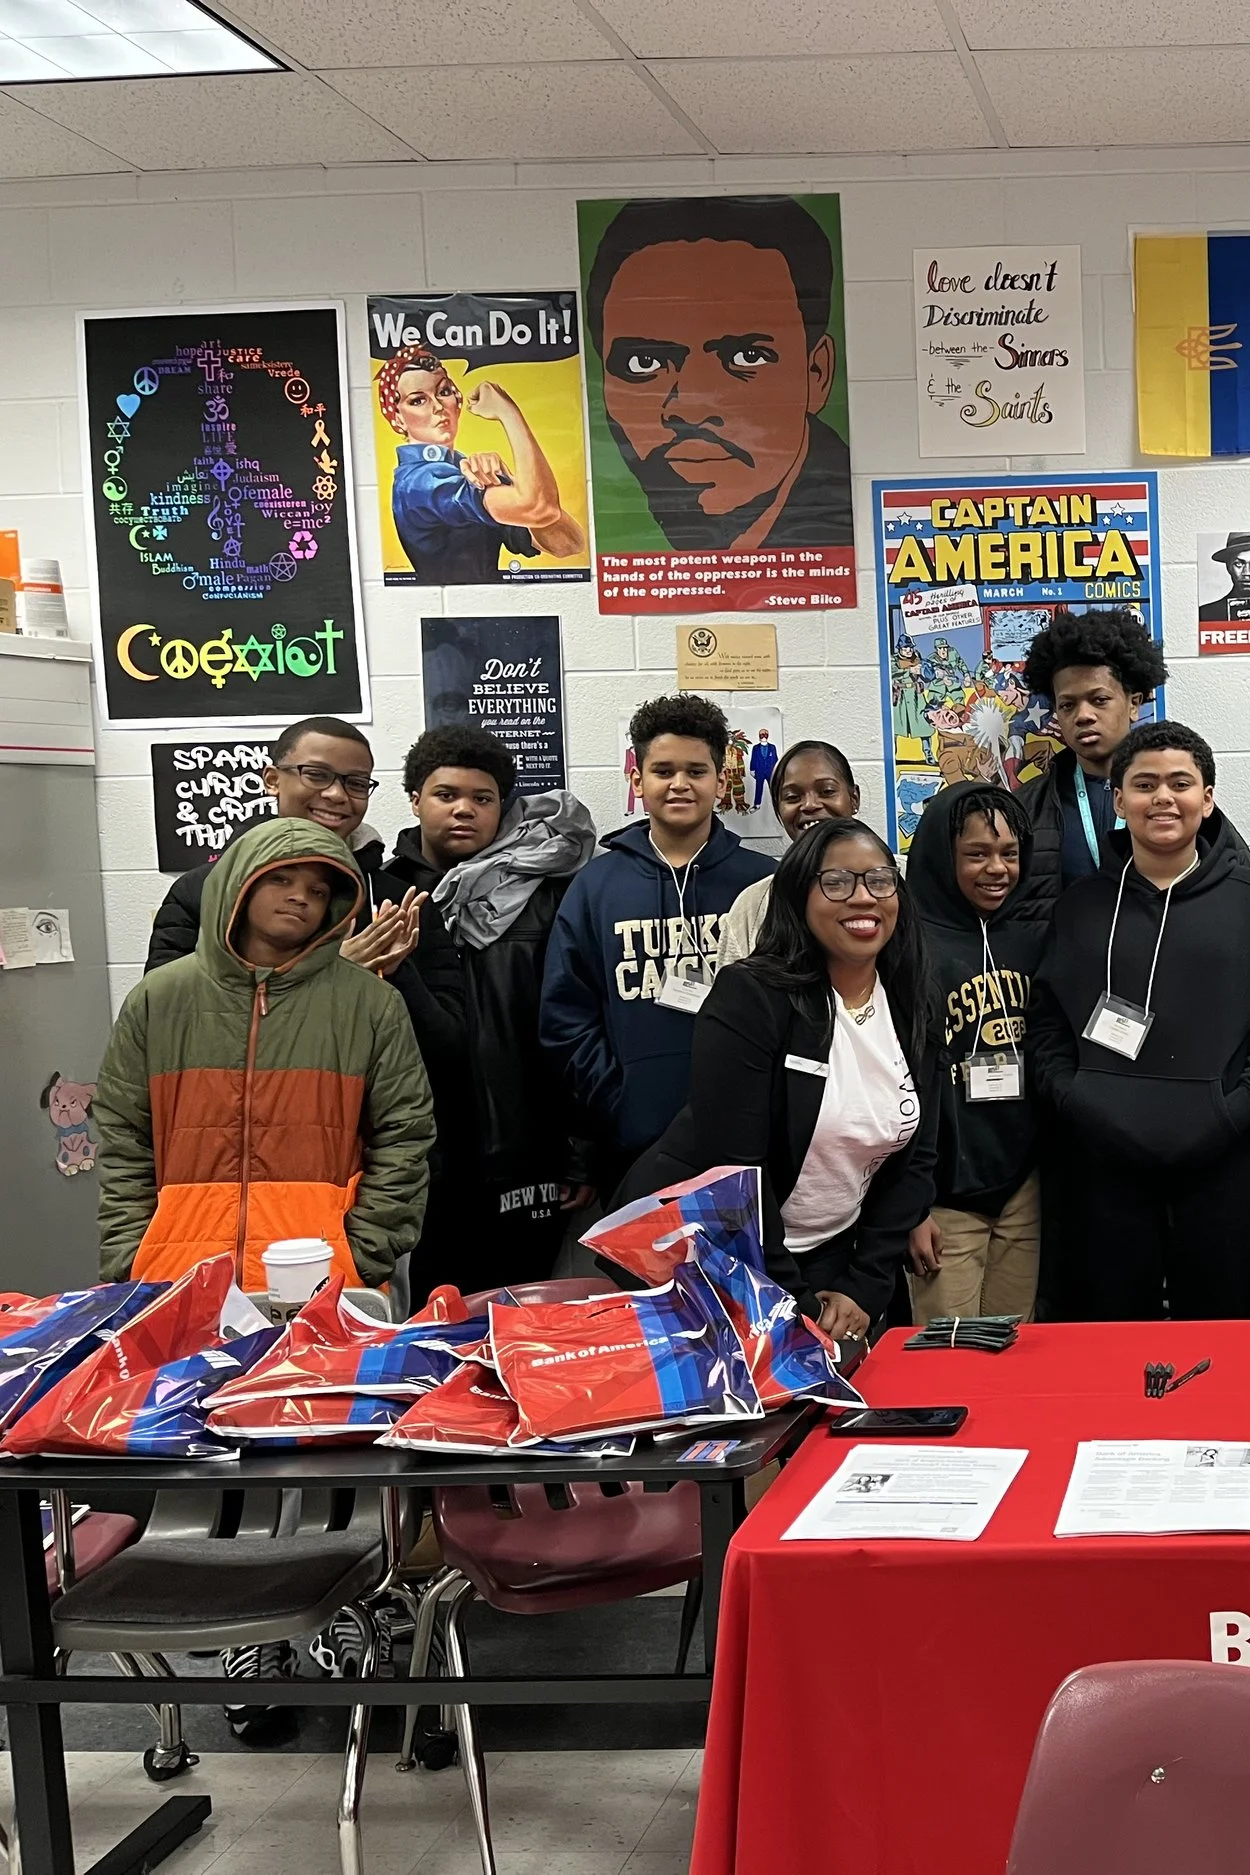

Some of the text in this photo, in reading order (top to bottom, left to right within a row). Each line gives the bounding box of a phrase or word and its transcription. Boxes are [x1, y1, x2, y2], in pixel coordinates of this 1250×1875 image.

[984, 260, 1058, 292] doesn't
[922, 298, 1049, 328] Discriminate
[372, 309, 573, 348] We Can Do It!
[200, 339, 221, 348] art
[176, 345, 202, 358] hope
[216, 348, 263, 356] JUSTICE
[994, 333, 1070, 370] Sinners
[228, 354, 260, 363] care
[268, 369, 300, 378] Vrede
[198, 382, 233, 394] share
[945, 378, 962, 394] the
[960, 380, 1052, 428] Saints
[301, 403, 326, 417] 和平
[202, 432, 235, 443] LIFE
[194, 457, 214, 466] faith
[236, 458, 260, 471] ishq
[233, 472, 280, 482] Judaism
[166, 482, 218, 494] imagine
[244, 484, 292, 500] female
[150, 493, 210, 505] kindness
[109, 503, 134, 515] 共存
[141, 506, 189, 516] Truth
[311, 501, 333, 514] joy
[930, 493, 1095, 530] CAPTAIN
[262, 510, 310, 518] Wiccan
[140, 552, 173, 562] ISLAM
[602, 552, 822, 568] The most potent weapon in the
[889, 529, 1139, 585] AMERICA
[152, 563, 194, 575] Buddhism
[210, 558, 246, 569] Hindu
[246, 564, 270, 574] math
[200, 571, 234, 586] male
[236, 574, 271, 584] Pagan
[604, 566, 850, 582] hands of the oppressor is the minds
[604, 585, 726, 599] of the oppressed.
[983, 587, 1024, 598] MARCH
[1085, 582, 1141, 598] COMICS
[810, 595, 842, 605] Biko
[942, 600, 978, 612] AMERICA
[952, 612, 973, 620] OTHER
[928, 623, 950, 632] GREAT
[480, 658, 542, 680] Don't
[472, 683, 550, 695] BELIEVE
[468, 698, 556, 714] EVERYTHING
[481, 719, 498, 728] you
[499, 716, 520, 726] read
[532, 716, 546, 725] the
[490, 730, 542, 738] NTERNET
[520, 741, 548, 750] there's a
[173, 744, 273, 770] SPARK
[176, 772, 267, 800] CURIO
[176, 796, 278, 825] & CRITI
[176, 824, 234, 850] THI
[614, 914, 719, 959] TURK
[946, 969, 1030, 1046] SSENTI
[500, 1183, 558, 1213] NEW YO
[531, 1336, 669, 1368] Bank of America
